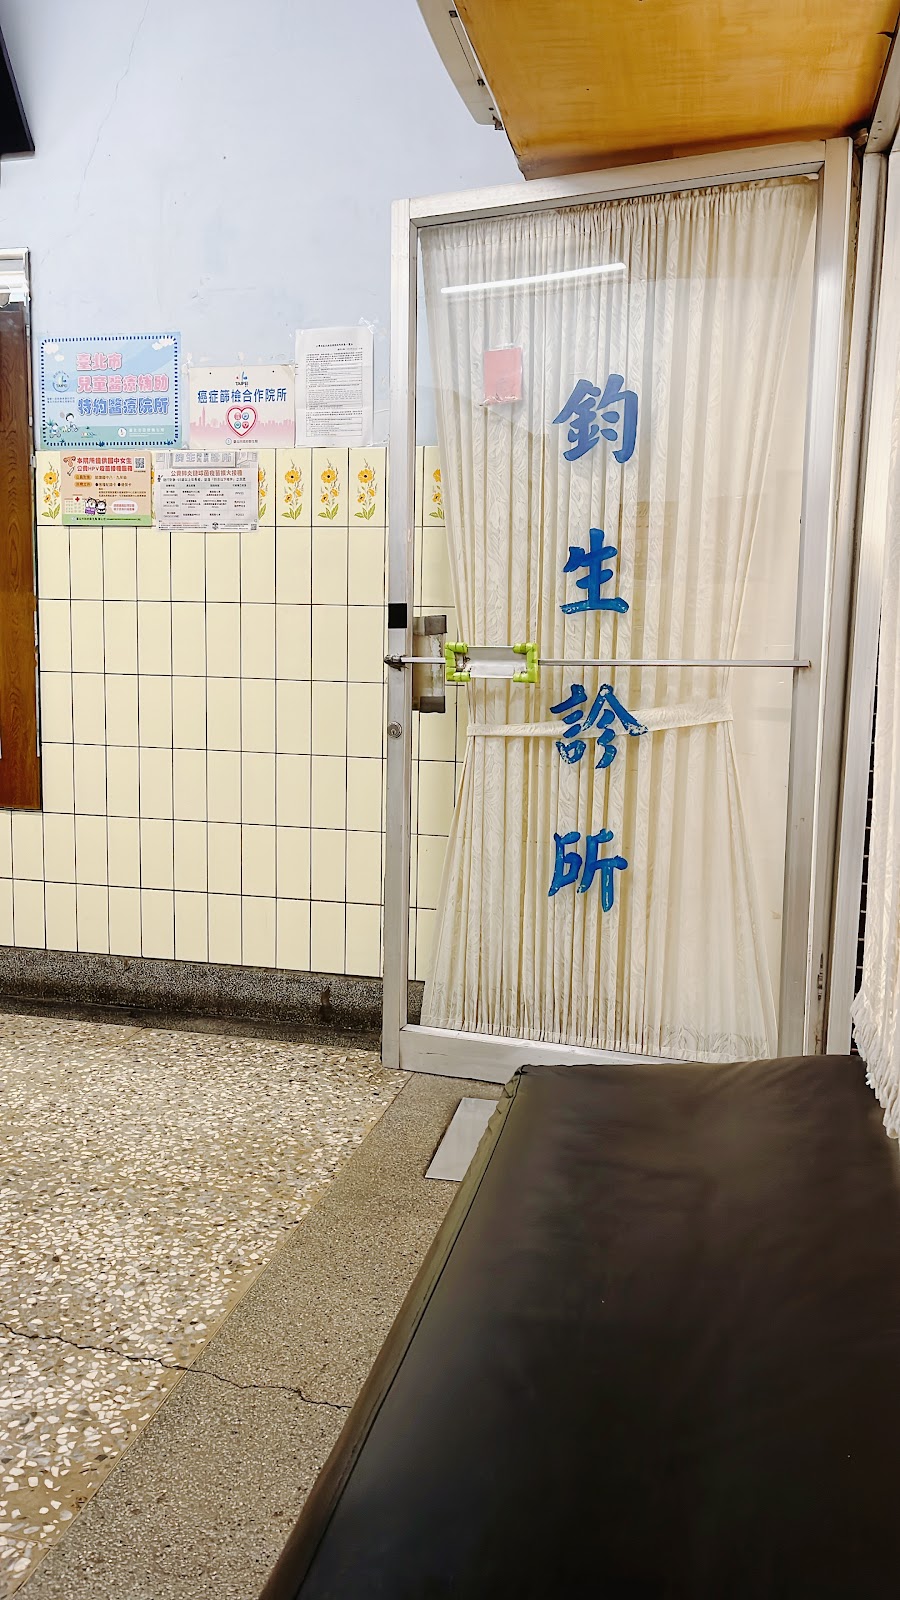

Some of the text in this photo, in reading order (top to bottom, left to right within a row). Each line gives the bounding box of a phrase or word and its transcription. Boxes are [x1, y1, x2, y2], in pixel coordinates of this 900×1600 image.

[76, 353, 122, 371] 臺北市
[77, 374, 169, 393] 兒童醫療補助
[197, 388, 287, 404] 癌症篩檢合作院所
[78, 397, 170, 415] 特約醫療院所
[548, 373, 648, 912] 鈞生診所
